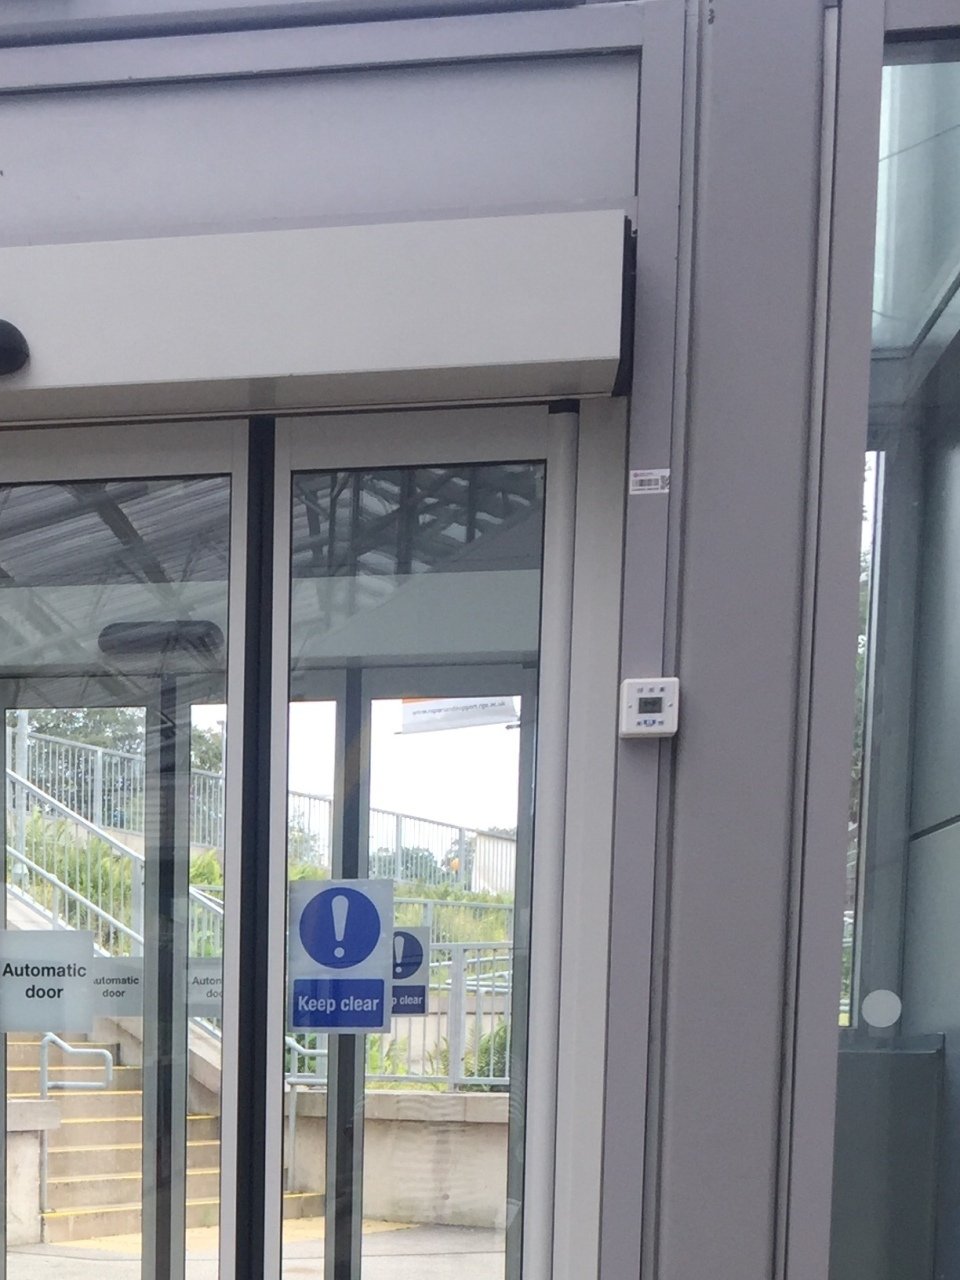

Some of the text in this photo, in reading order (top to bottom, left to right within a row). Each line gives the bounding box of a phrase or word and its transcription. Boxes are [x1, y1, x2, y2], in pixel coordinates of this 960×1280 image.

[2, 962, 87, 978] Automatic
[93, 976, 139, 985] utomatic
[25, 985, 64, 999] door
[102, 989, 125, 998] door
[298, 996, 336, 1014] Keep
[340, 996, 380, 1011] clear
[399, 995, 423, 1005] clear
